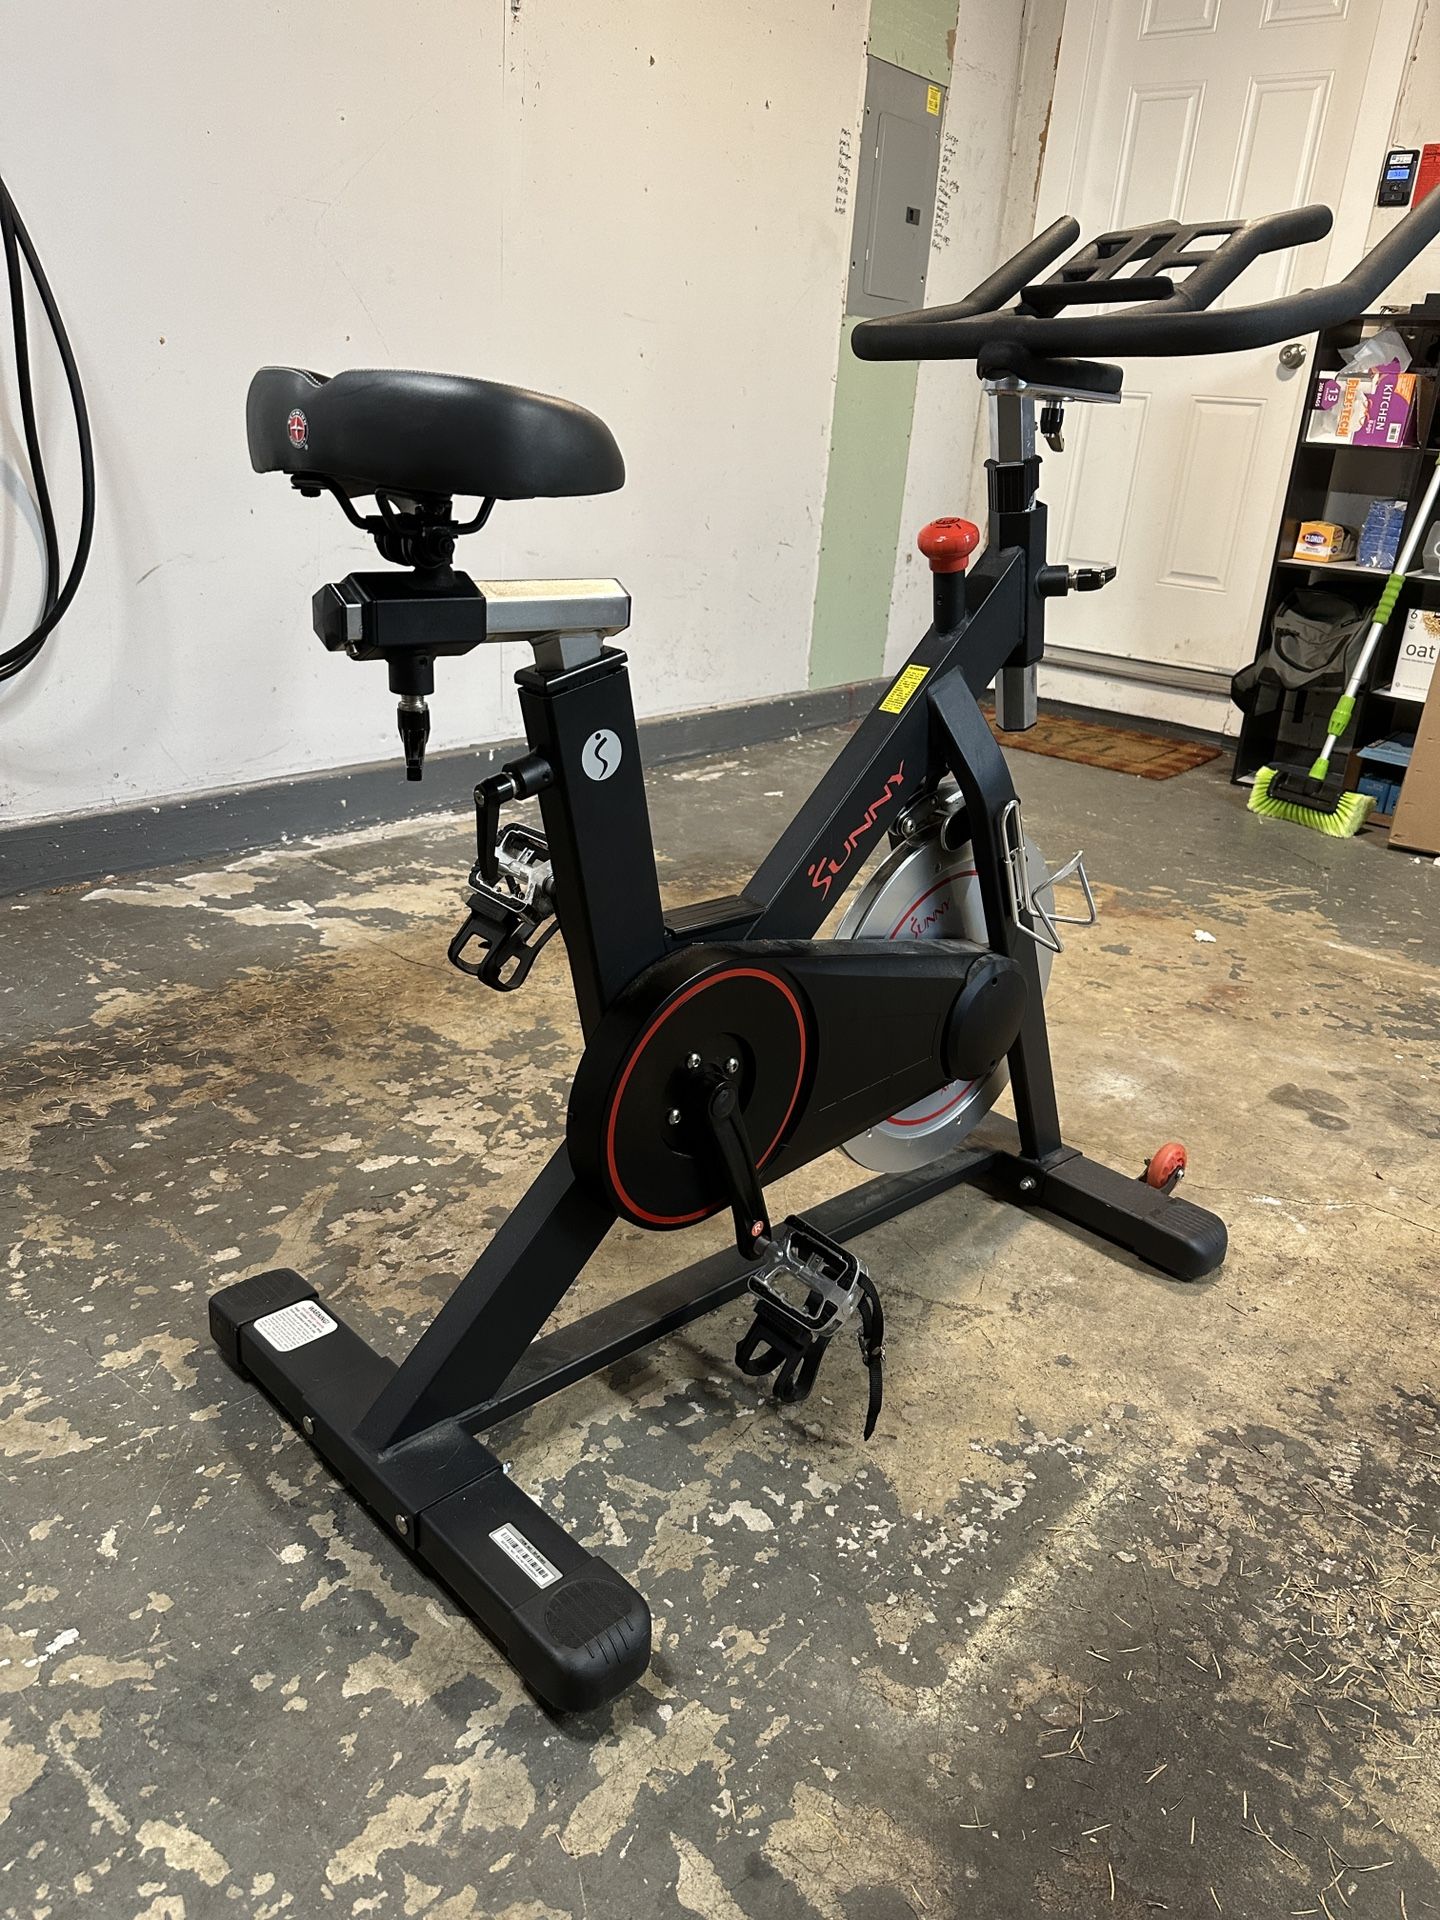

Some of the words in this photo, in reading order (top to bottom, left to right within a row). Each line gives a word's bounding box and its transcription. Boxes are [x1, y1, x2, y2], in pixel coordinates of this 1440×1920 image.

[1328, 388, 1339, 402] 13
[1375, 384, 1394, 430] KITCHEN
[1405, 643, 1436, 660] oat
[808, 760, 904, 901] SUNNY
[910, 896, 951, 939] SUNNY
